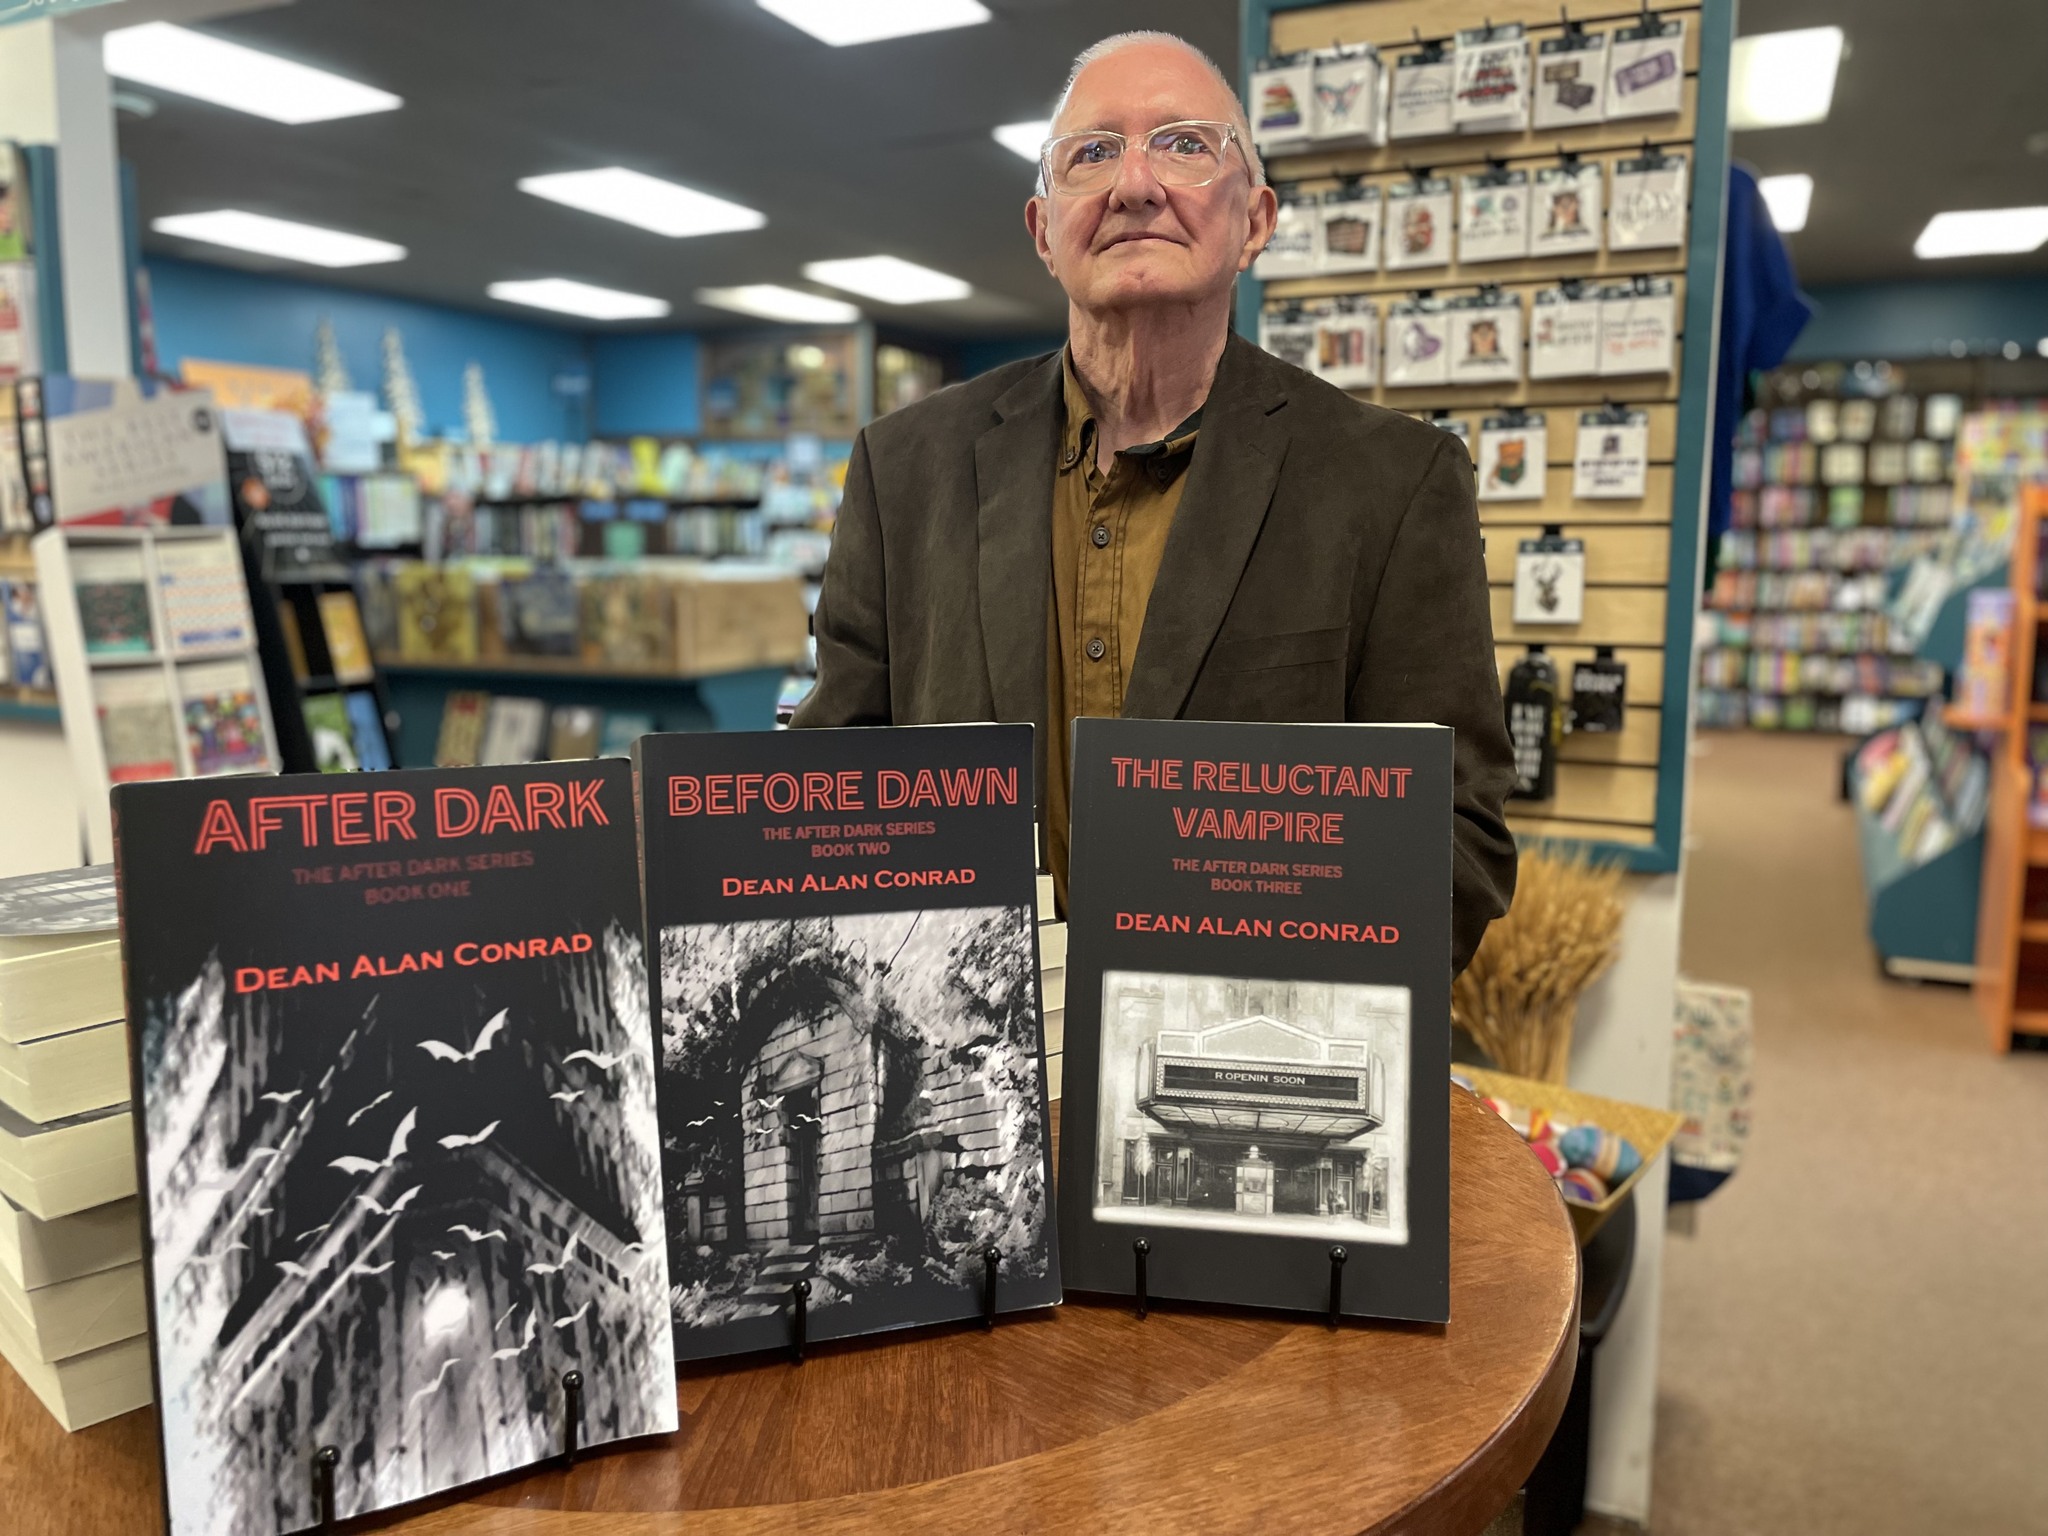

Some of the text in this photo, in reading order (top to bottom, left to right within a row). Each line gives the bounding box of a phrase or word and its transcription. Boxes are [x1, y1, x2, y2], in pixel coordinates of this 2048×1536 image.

[668, 768, 1018, 816] BEFORE DAWN
[1112, 757, 1412, 798] THE RELUCTANT
[195, 790, 416, 854] AFTER
[434, 780, 608, 838] DARK
[763, 821, 936, 840] THE AFTER DARK SERIES
[1173, 807, 1344, 844] VAMPIRE
[811, 841, 890, 858] BOOK TWO
[294, 850, 533, 884] THE AFTER DARK SERIES
[1173, 858, 1343, 878] THE AFTER DARK SERIES
[364, 879, 470, 905] BOOK ONE
[1210, 878, 1302, 895] BOOK THREE
[1116, 912, 1399, 944] DEAN ALAN CONRAD
[1225, 1072, 1268, 1083] OPENIN
[1273, 1075, 1306, 1085] SOON
